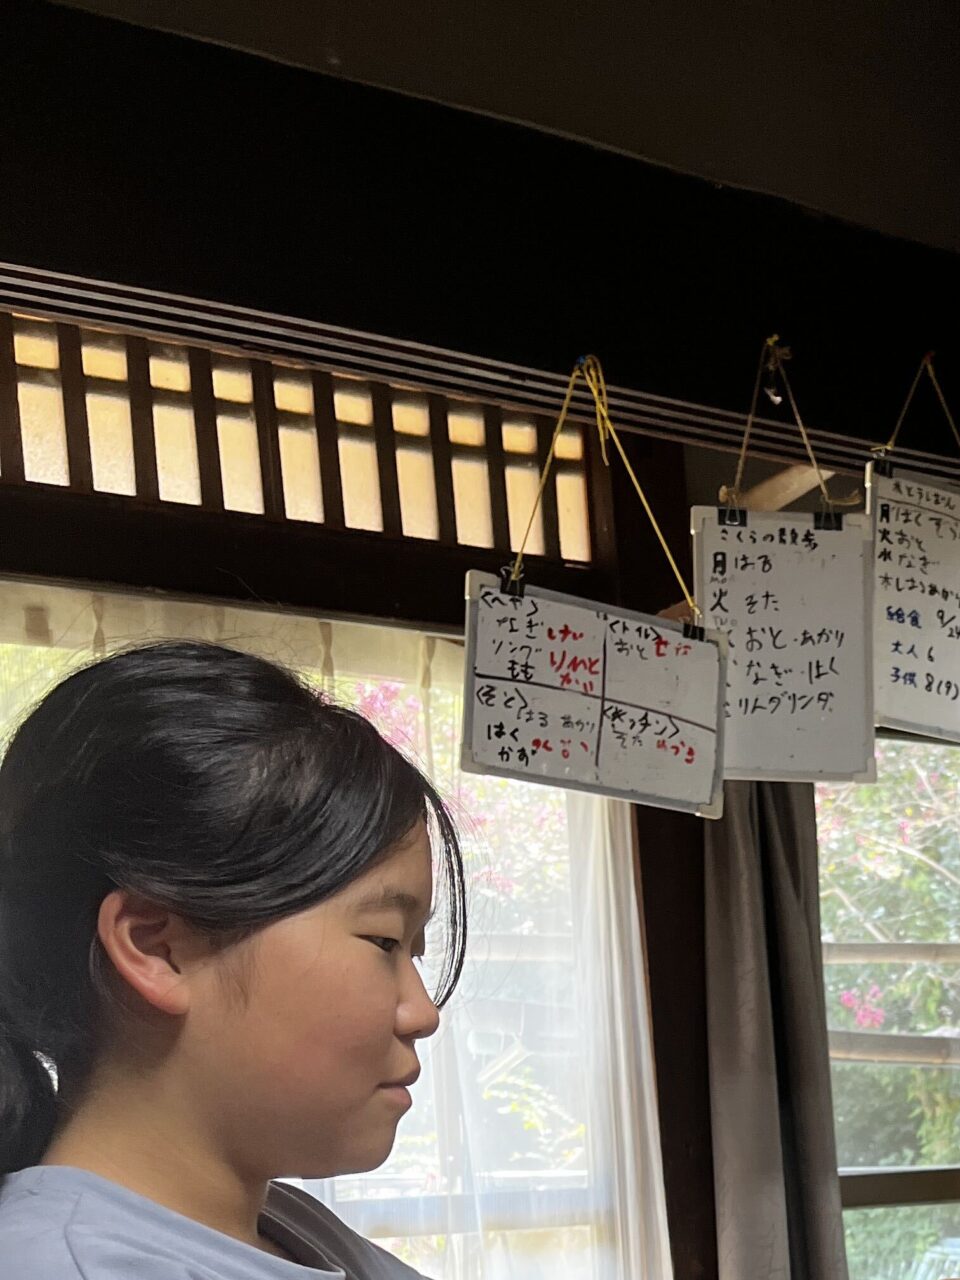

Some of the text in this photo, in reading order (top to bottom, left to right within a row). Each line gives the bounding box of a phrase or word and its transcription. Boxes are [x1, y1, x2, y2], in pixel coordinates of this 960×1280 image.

[879, 503, 890, 523] 月
[712, 550, 728, 574] 月
[710, 589, 729, 613] 火
[891, 641, 918, 660] 大人
